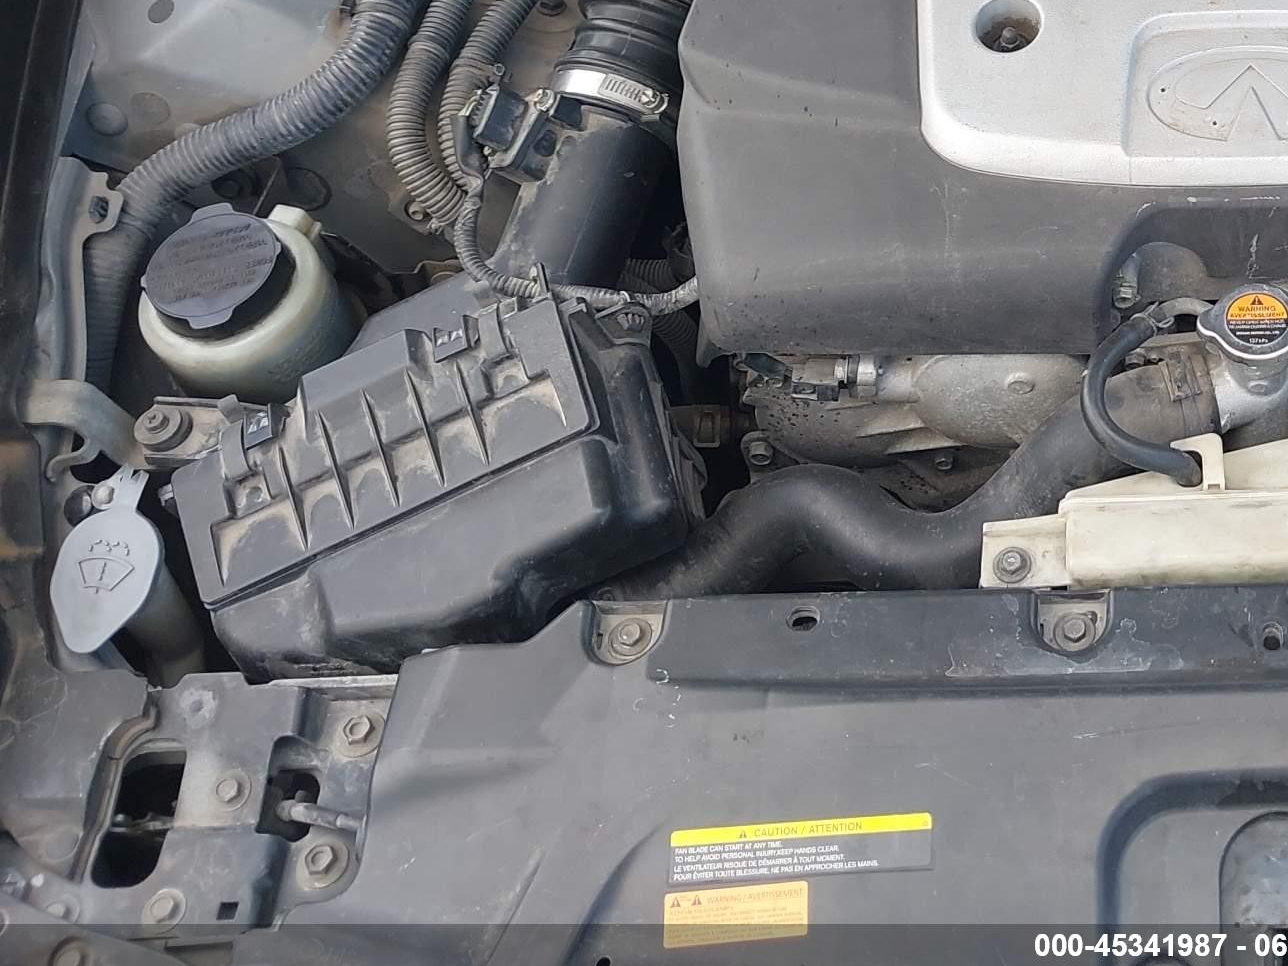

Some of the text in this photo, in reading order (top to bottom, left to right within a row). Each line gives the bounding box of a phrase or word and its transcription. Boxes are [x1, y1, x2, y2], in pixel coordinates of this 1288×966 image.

[754, 826, 798, 837] CAUTION
[809, 821, 863, 834] ATTENTION
[675, 847, 687, 855] FAN
[688, 845, 709, 854] BLADE
[709, 844, 723, 852] CAN
[724, 843, 744, 851] START
[753, 841, 767, 849] ANY
[675, 855, 684, 863] TO
[684, 854, 701, 862] HELP
[702, 853, 721, 861] AVOID
[721, 850, 755, 860] PERSONAL
[794, 846, 817, 855] HANDS
[674, 865, 682, 873] LE
[683, 862, 723, 872] VENTILATEUR
[723, 860, 747, 869] RISQUE
[748, 859, 758, 867] DE
[800, 855, 816, 863] TOUT
[674, 872, 692, 881] POUR
[715, 869, 736, 878] TOUTE
[771, 865, 781, 874] NE
[781, 864, 794, 873] PAS
[804, 861, 844, 871] APPROCHER
[845, 860, 857, 868] LES
